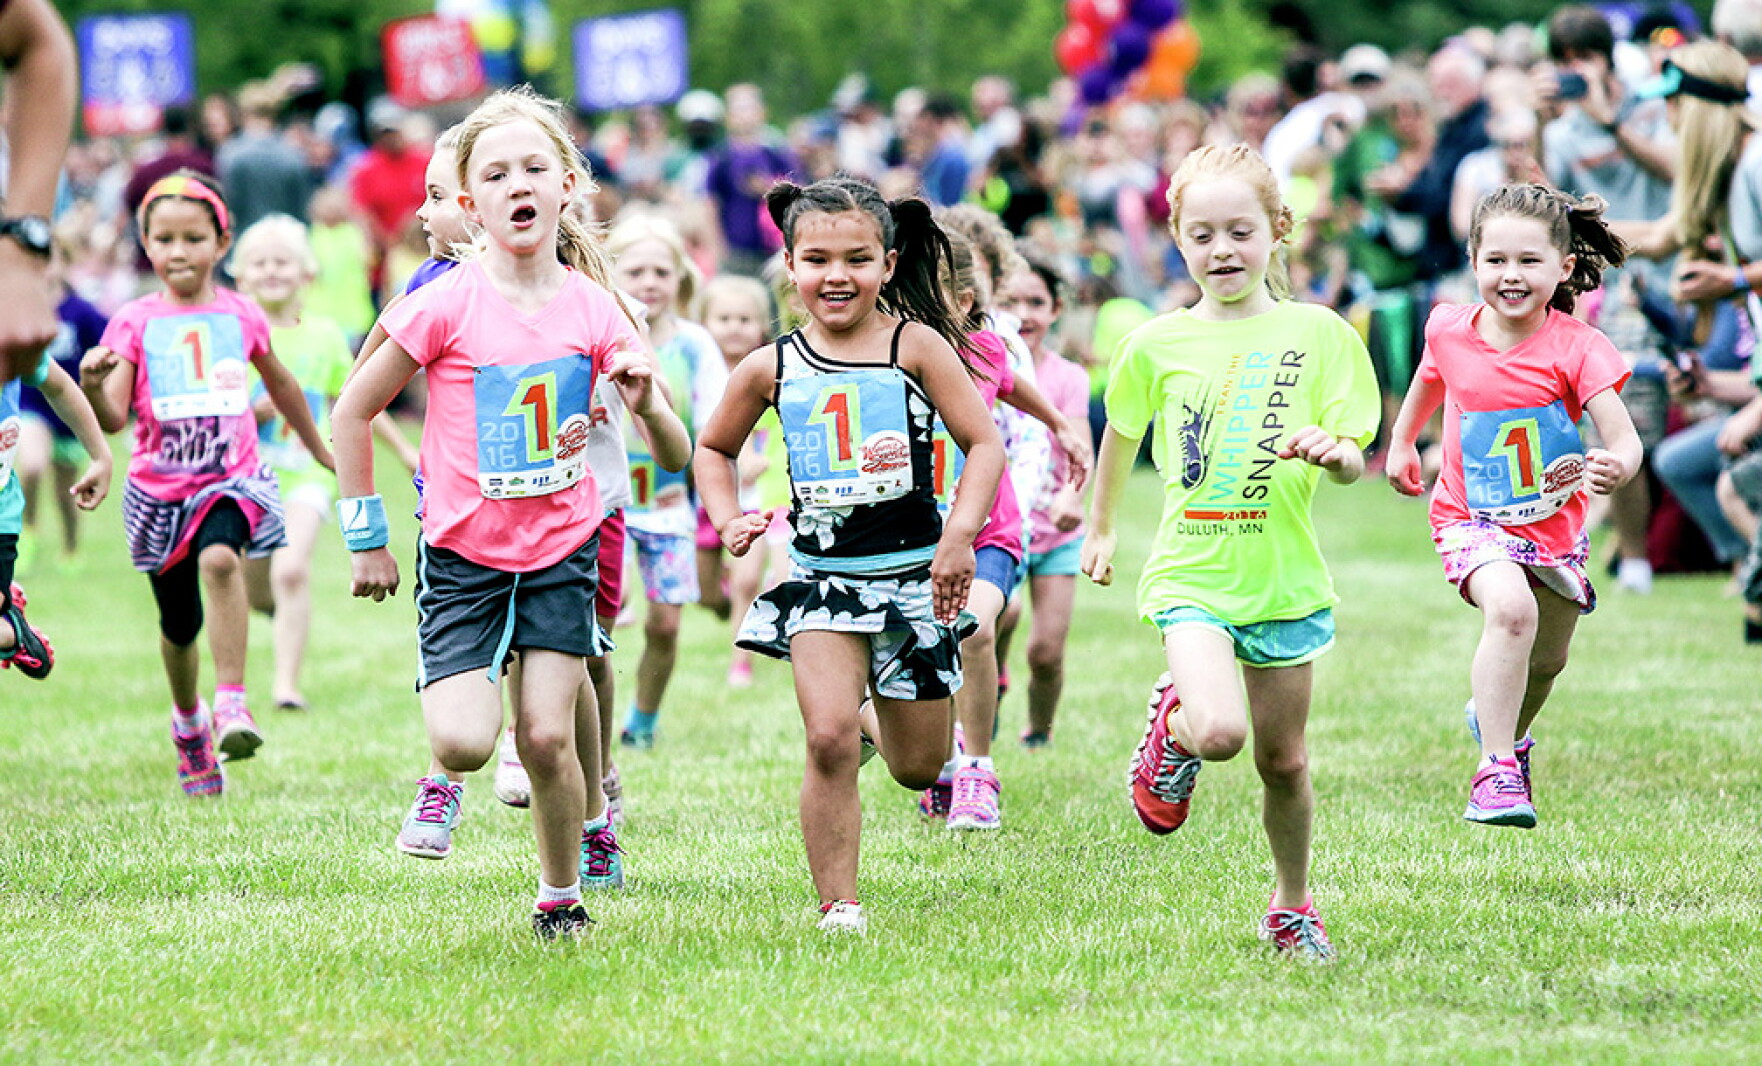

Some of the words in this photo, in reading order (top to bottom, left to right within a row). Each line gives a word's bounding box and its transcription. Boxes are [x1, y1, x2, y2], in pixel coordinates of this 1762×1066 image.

[481, 422, 520, 442] 20
[1208, 352, 1274, 501] WHIPPER
[1242, 350, 1306, 500] SNAPPER
[789, 431, 821, 450] 20
[486, 443, 518, 468] 16
[793, 453, 821, 476] 16
[1468, 463, 1504, 480] 20
[1471, 482, 1504, 503] 16
[1177, 522, 1235, 537] DULUTH,
[1239, 523, 1263, 535] MN
